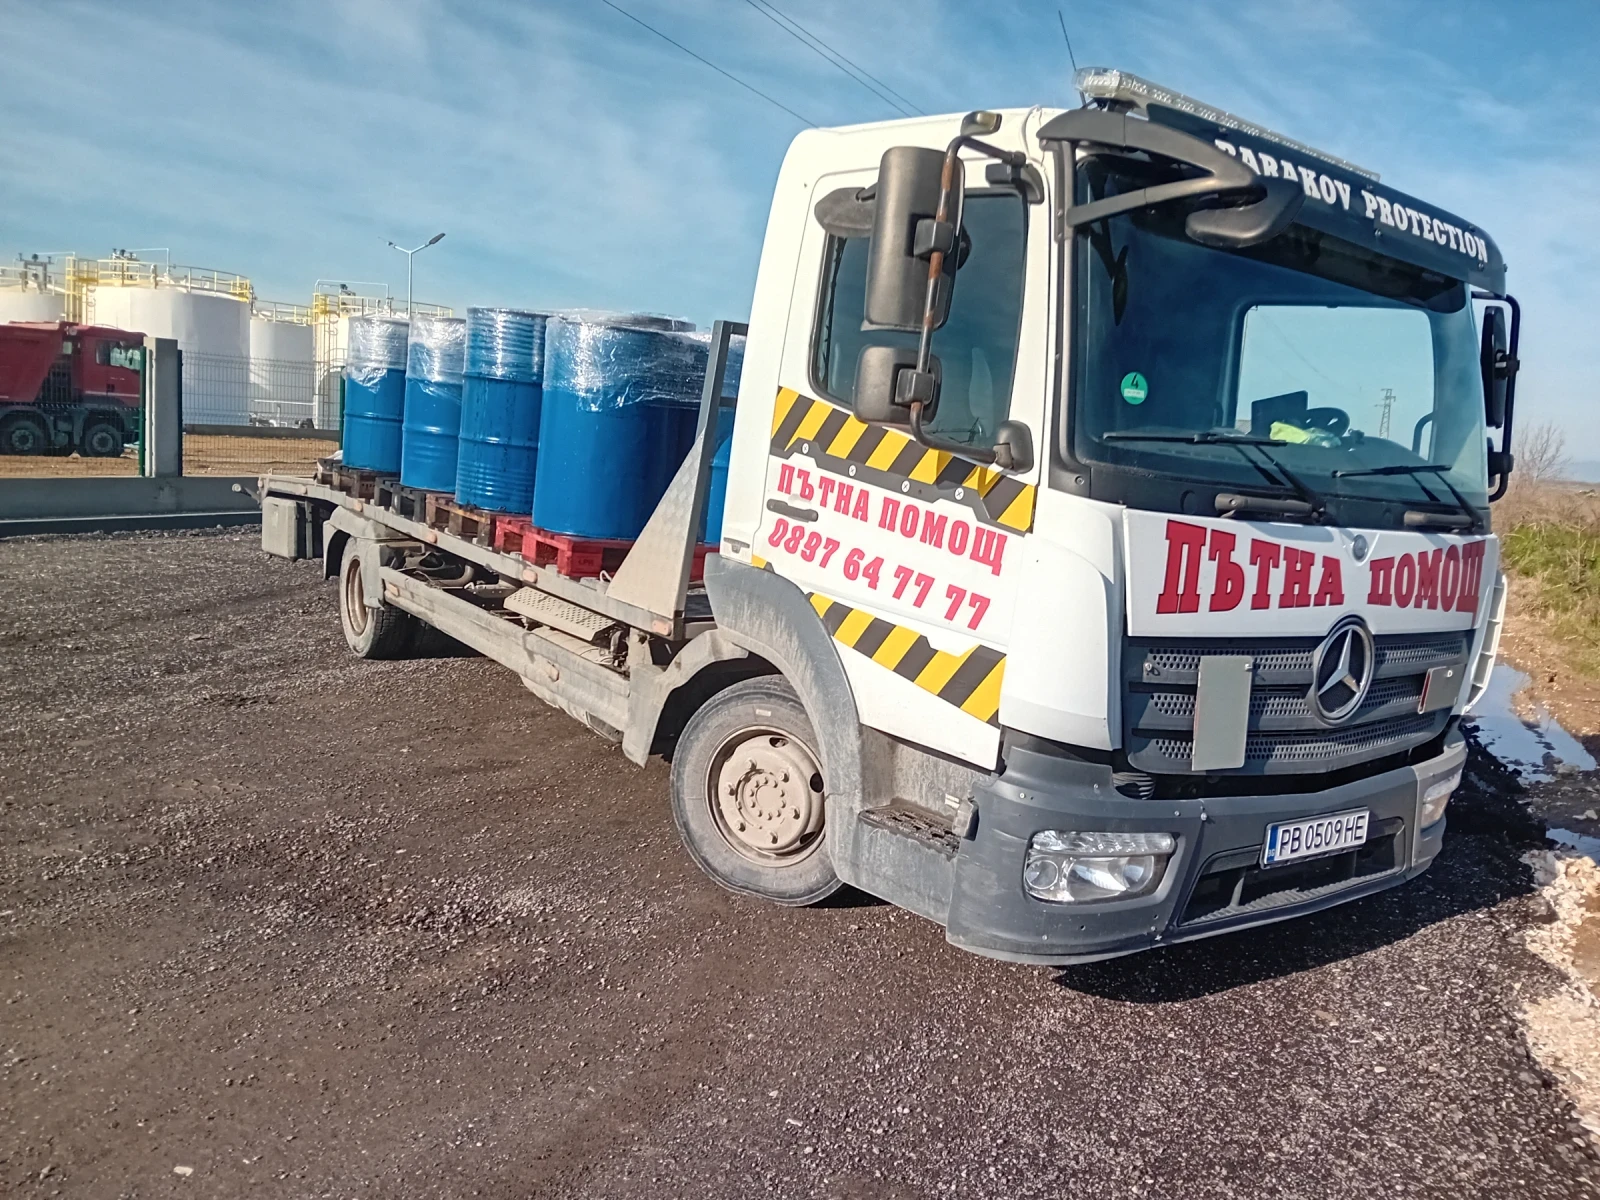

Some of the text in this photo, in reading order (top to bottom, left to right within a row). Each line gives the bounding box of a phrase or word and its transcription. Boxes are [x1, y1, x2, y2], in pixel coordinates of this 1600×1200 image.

[1361, 189, 1489, 263] PROTECTION
[1131, 372, 1139, 389] 4
[767, 518, 991, 630] 0897 64 77 77
[777, 463, 1008, 577] ПЪТНА ПОМОЩ
[1156, 519, 1487, 630] ПЪТНА ПОМОЩ
